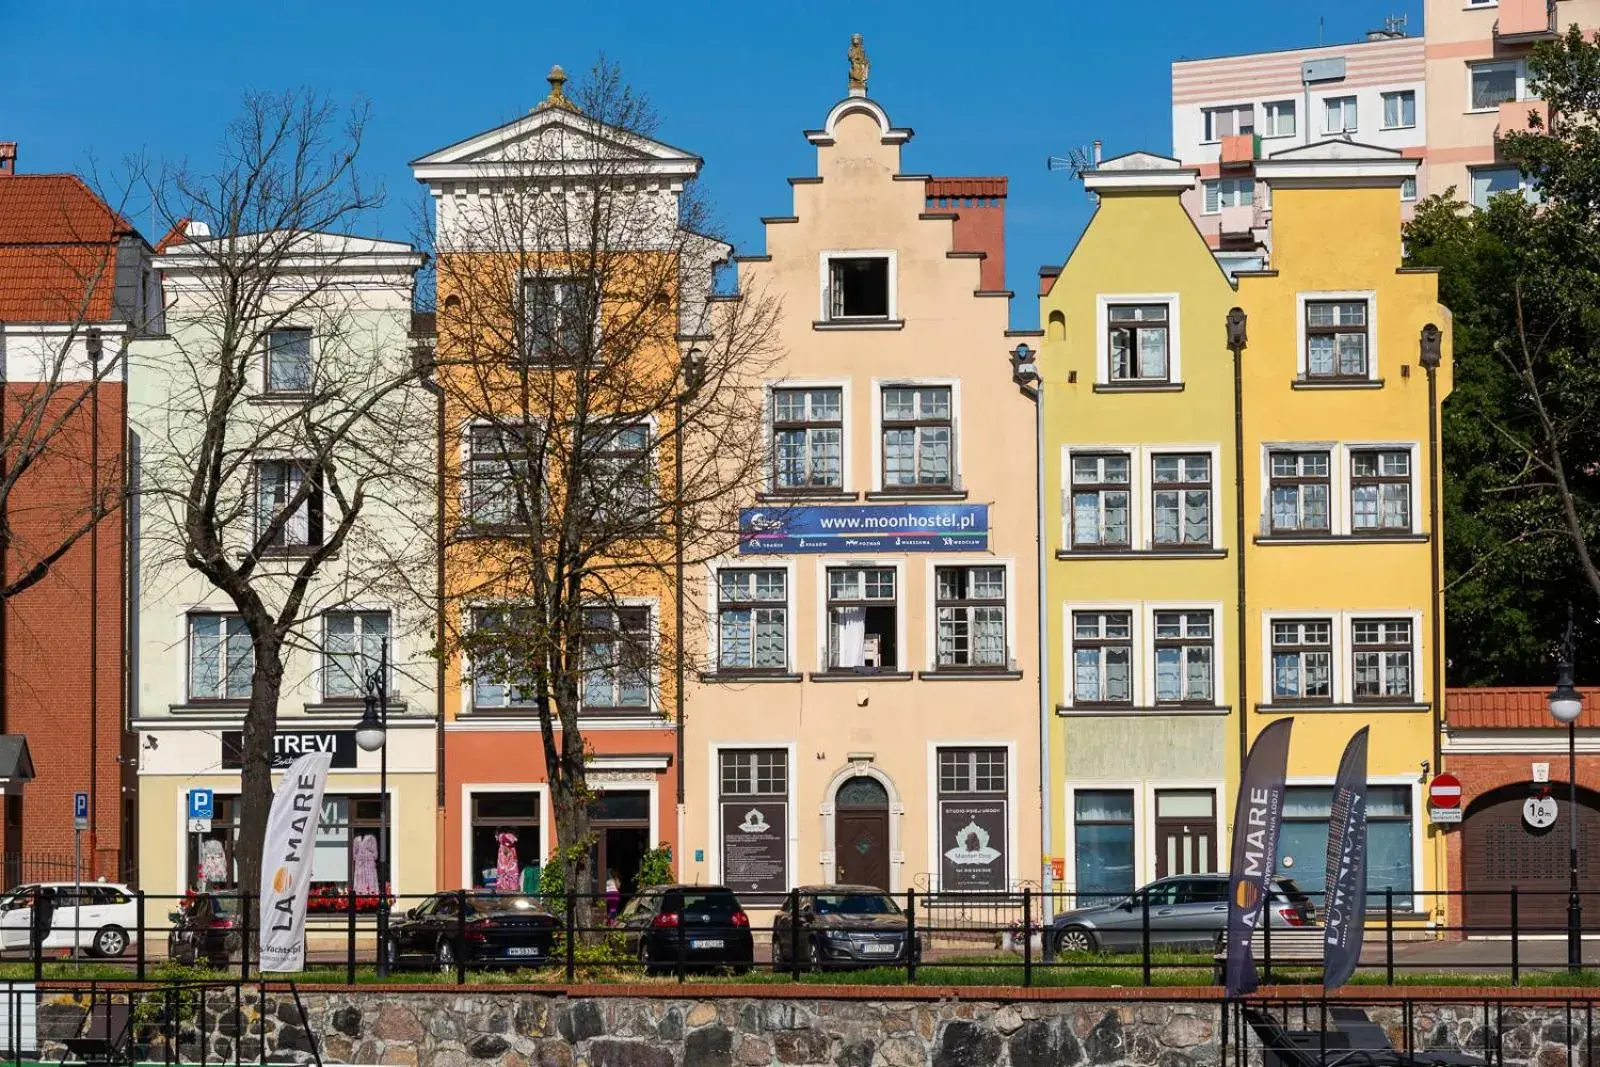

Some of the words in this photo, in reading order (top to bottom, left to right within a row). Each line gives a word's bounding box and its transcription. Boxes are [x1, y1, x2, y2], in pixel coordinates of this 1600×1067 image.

[820, 513, 975, 529] www.moonhostel.pl
[273, 734, 337, 754] TREVI
[77, 796, 86, 815] P
[194, 792, 208, 811] P
[1244, 787, 1269, 877] MARE
[272, 894, 297, 932] LA
[285, 774, 317, 862] MARE
